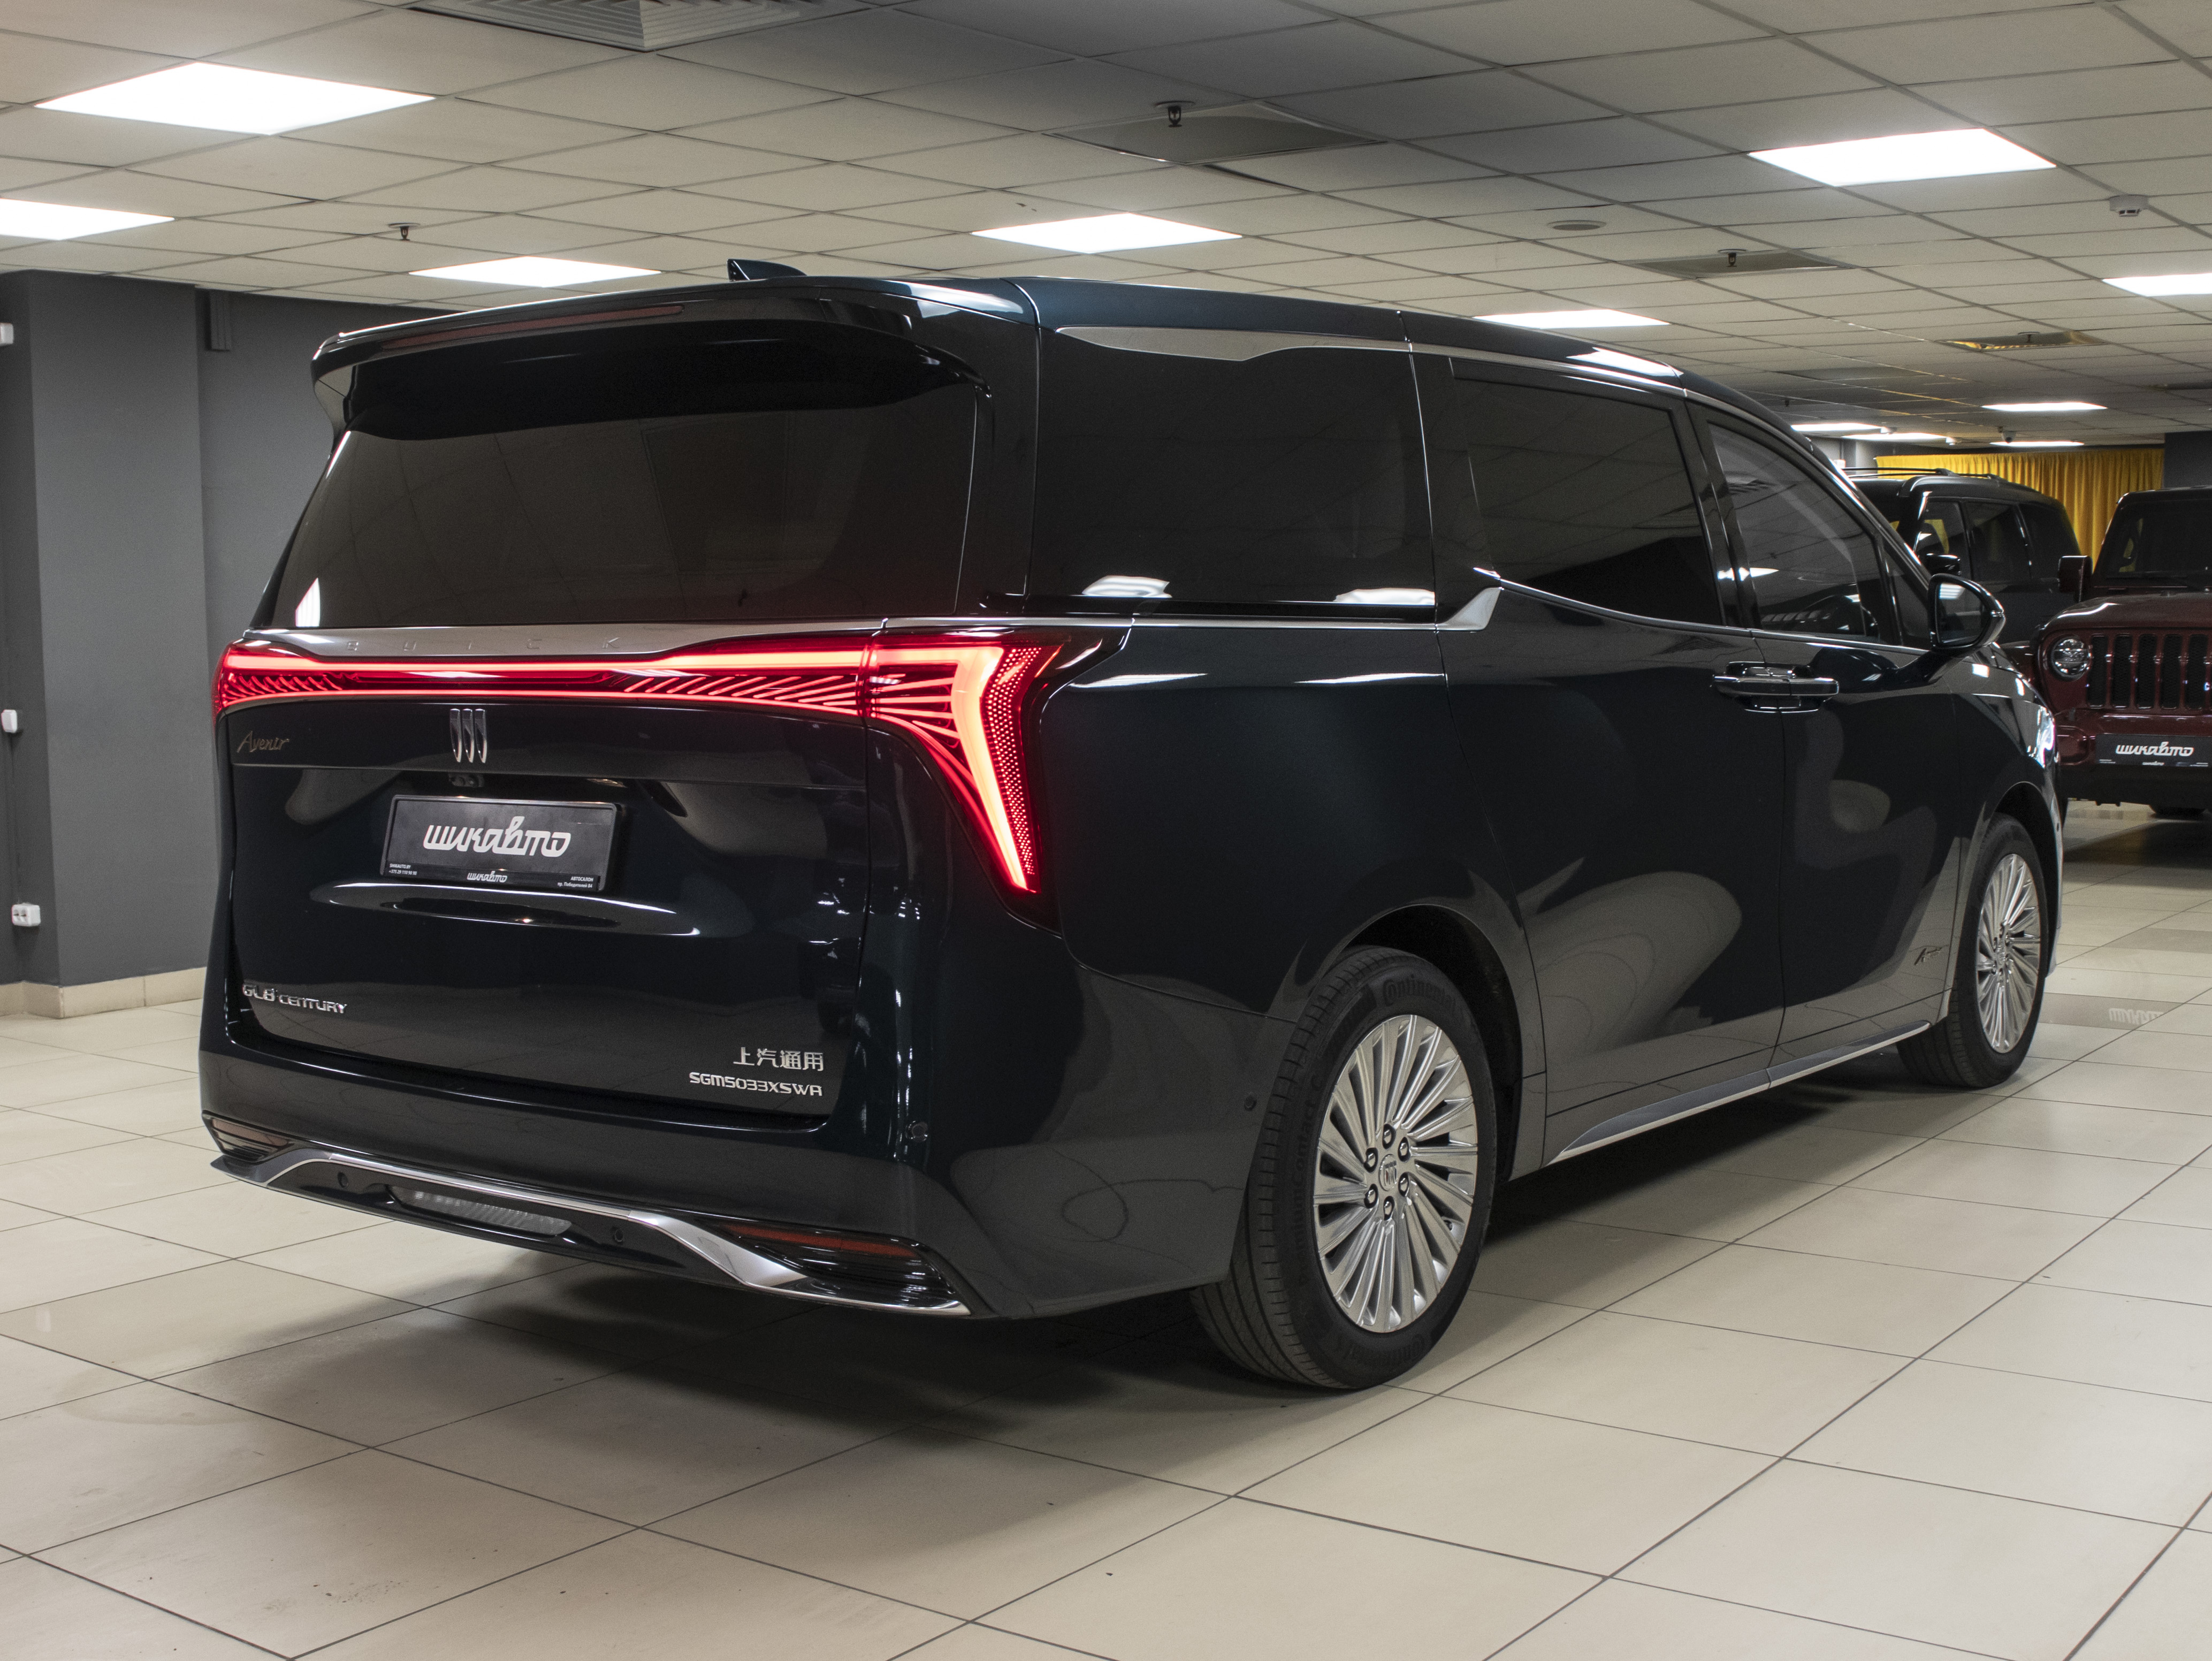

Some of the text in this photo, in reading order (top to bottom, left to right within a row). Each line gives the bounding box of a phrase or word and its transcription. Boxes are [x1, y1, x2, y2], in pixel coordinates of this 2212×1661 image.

[346, 637, 621, 651] BUICK
[237, 730, 289, 753] Avenir
[423, 816, 571, 857] шикавто
[242, 984, 347, 1014] GL8 CENTURY
[1383, 974, 1456, 1013] Continental
[733, 1047, 823, 1071] 上汽通用
[689, 1072, 822, 1096] SGM5033XSWA
